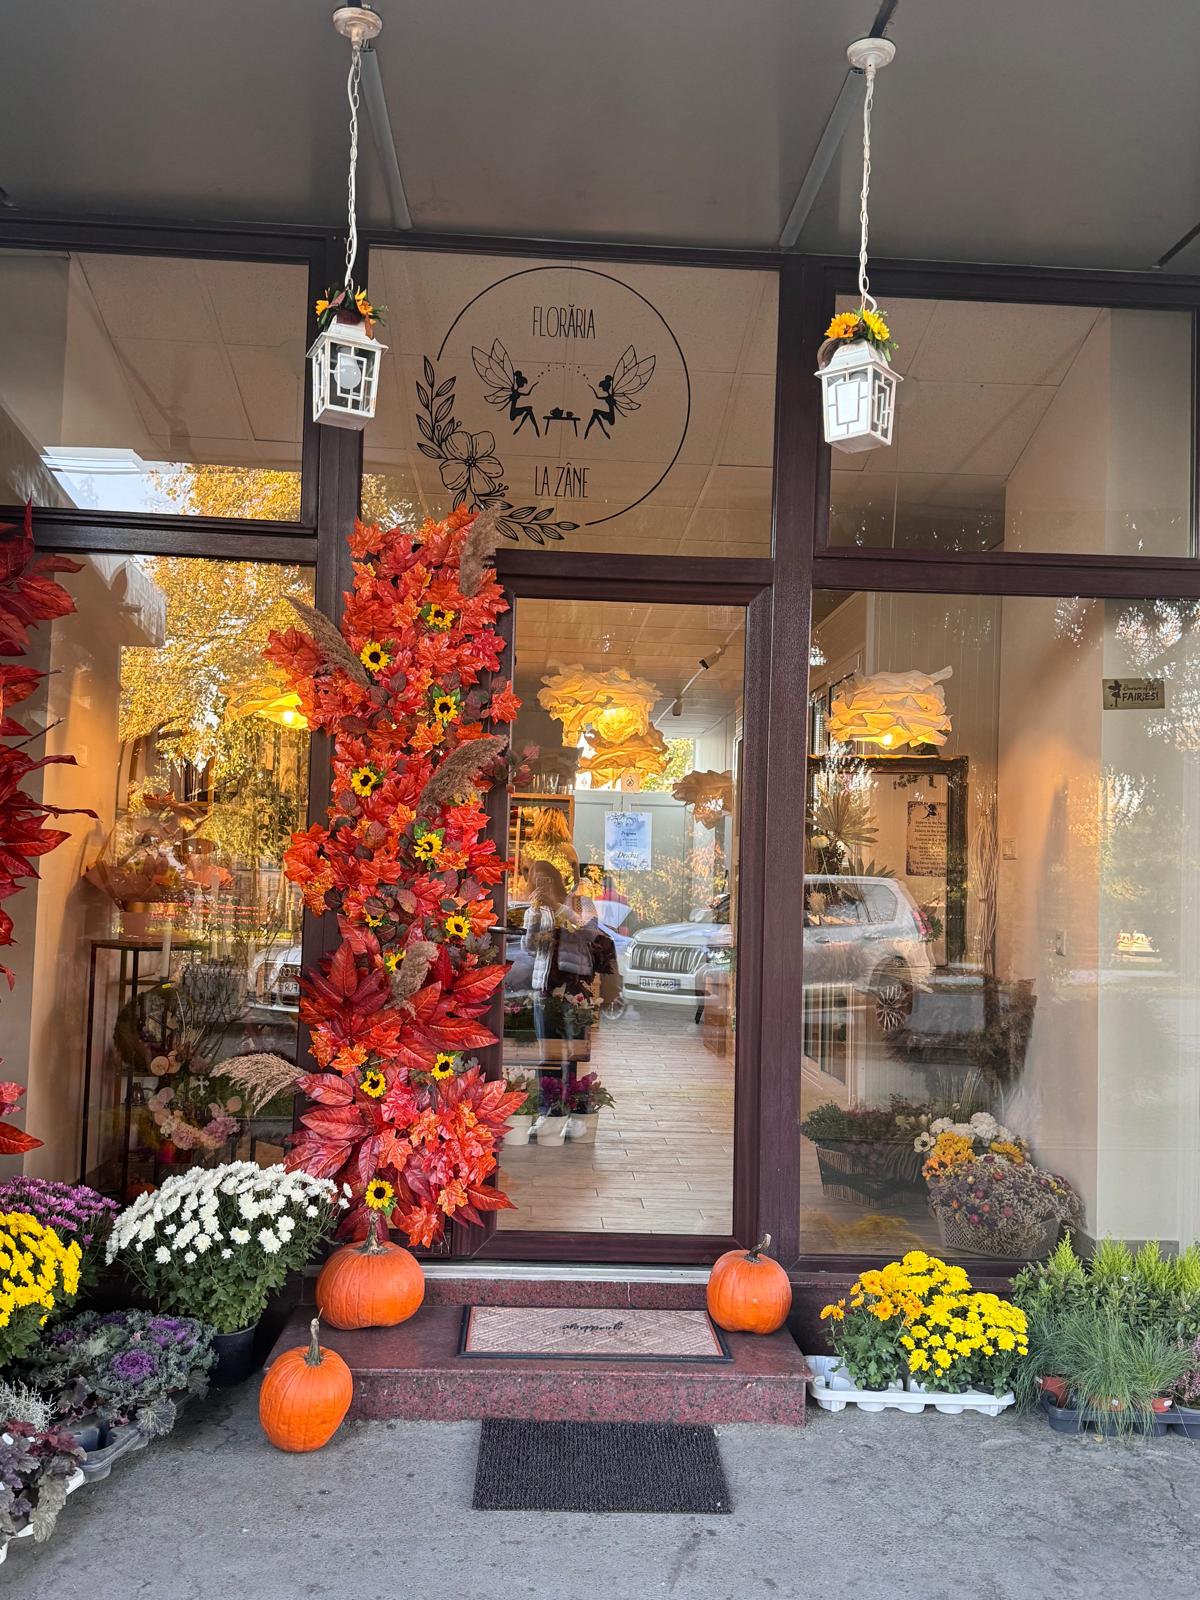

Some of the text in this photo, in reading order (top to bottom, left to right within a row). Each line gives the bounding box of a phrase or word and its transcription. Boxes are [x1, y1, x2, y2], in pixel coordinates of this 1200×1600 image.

[532, 304, 596, 340] FLORĂRIA
[534, 462, 590, 498] LA ZÂNE
[1122, 691, 1159, 702] FAIRIES!
